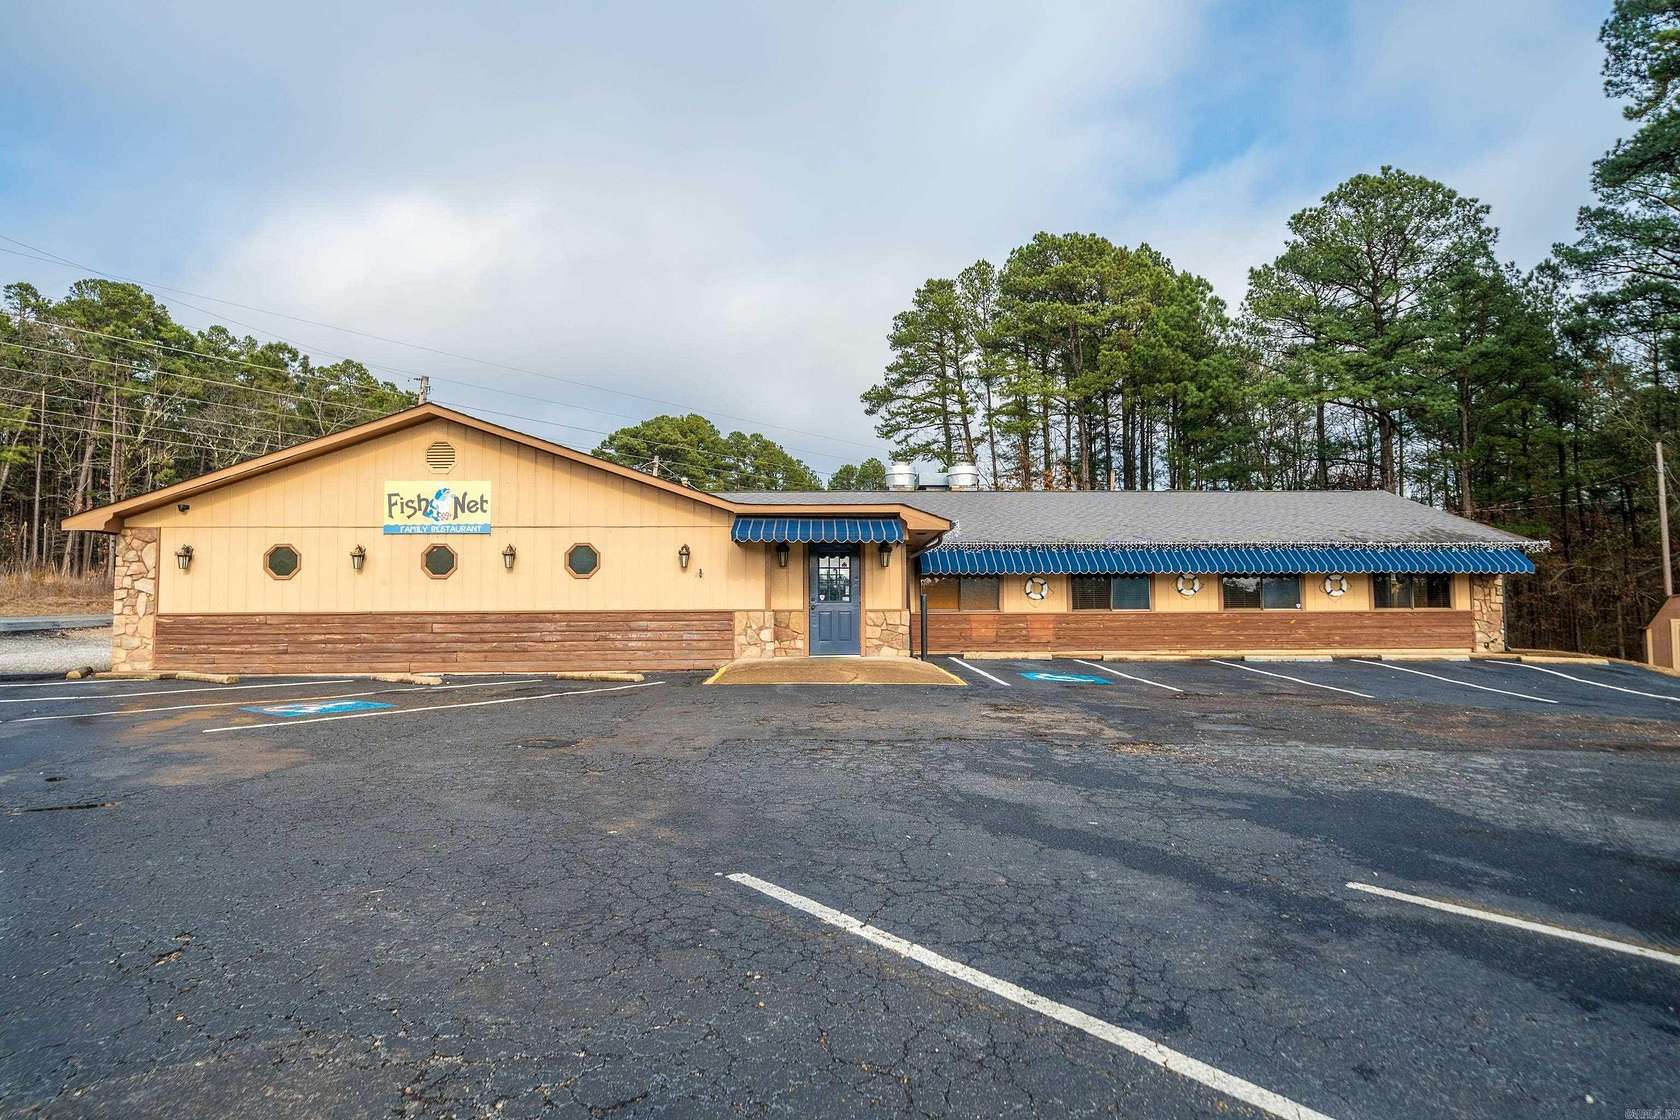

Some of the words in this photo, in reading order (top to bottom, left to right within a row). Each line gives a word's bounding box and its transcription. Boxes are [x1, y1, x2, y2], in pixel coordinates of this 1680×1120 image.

[387, 492, 430, 519] Fish
[452, 491, 489, 520] Net
[400, 525, 427, 533] FAMILY
[430, 525, 482, 533] RESTAURANT
